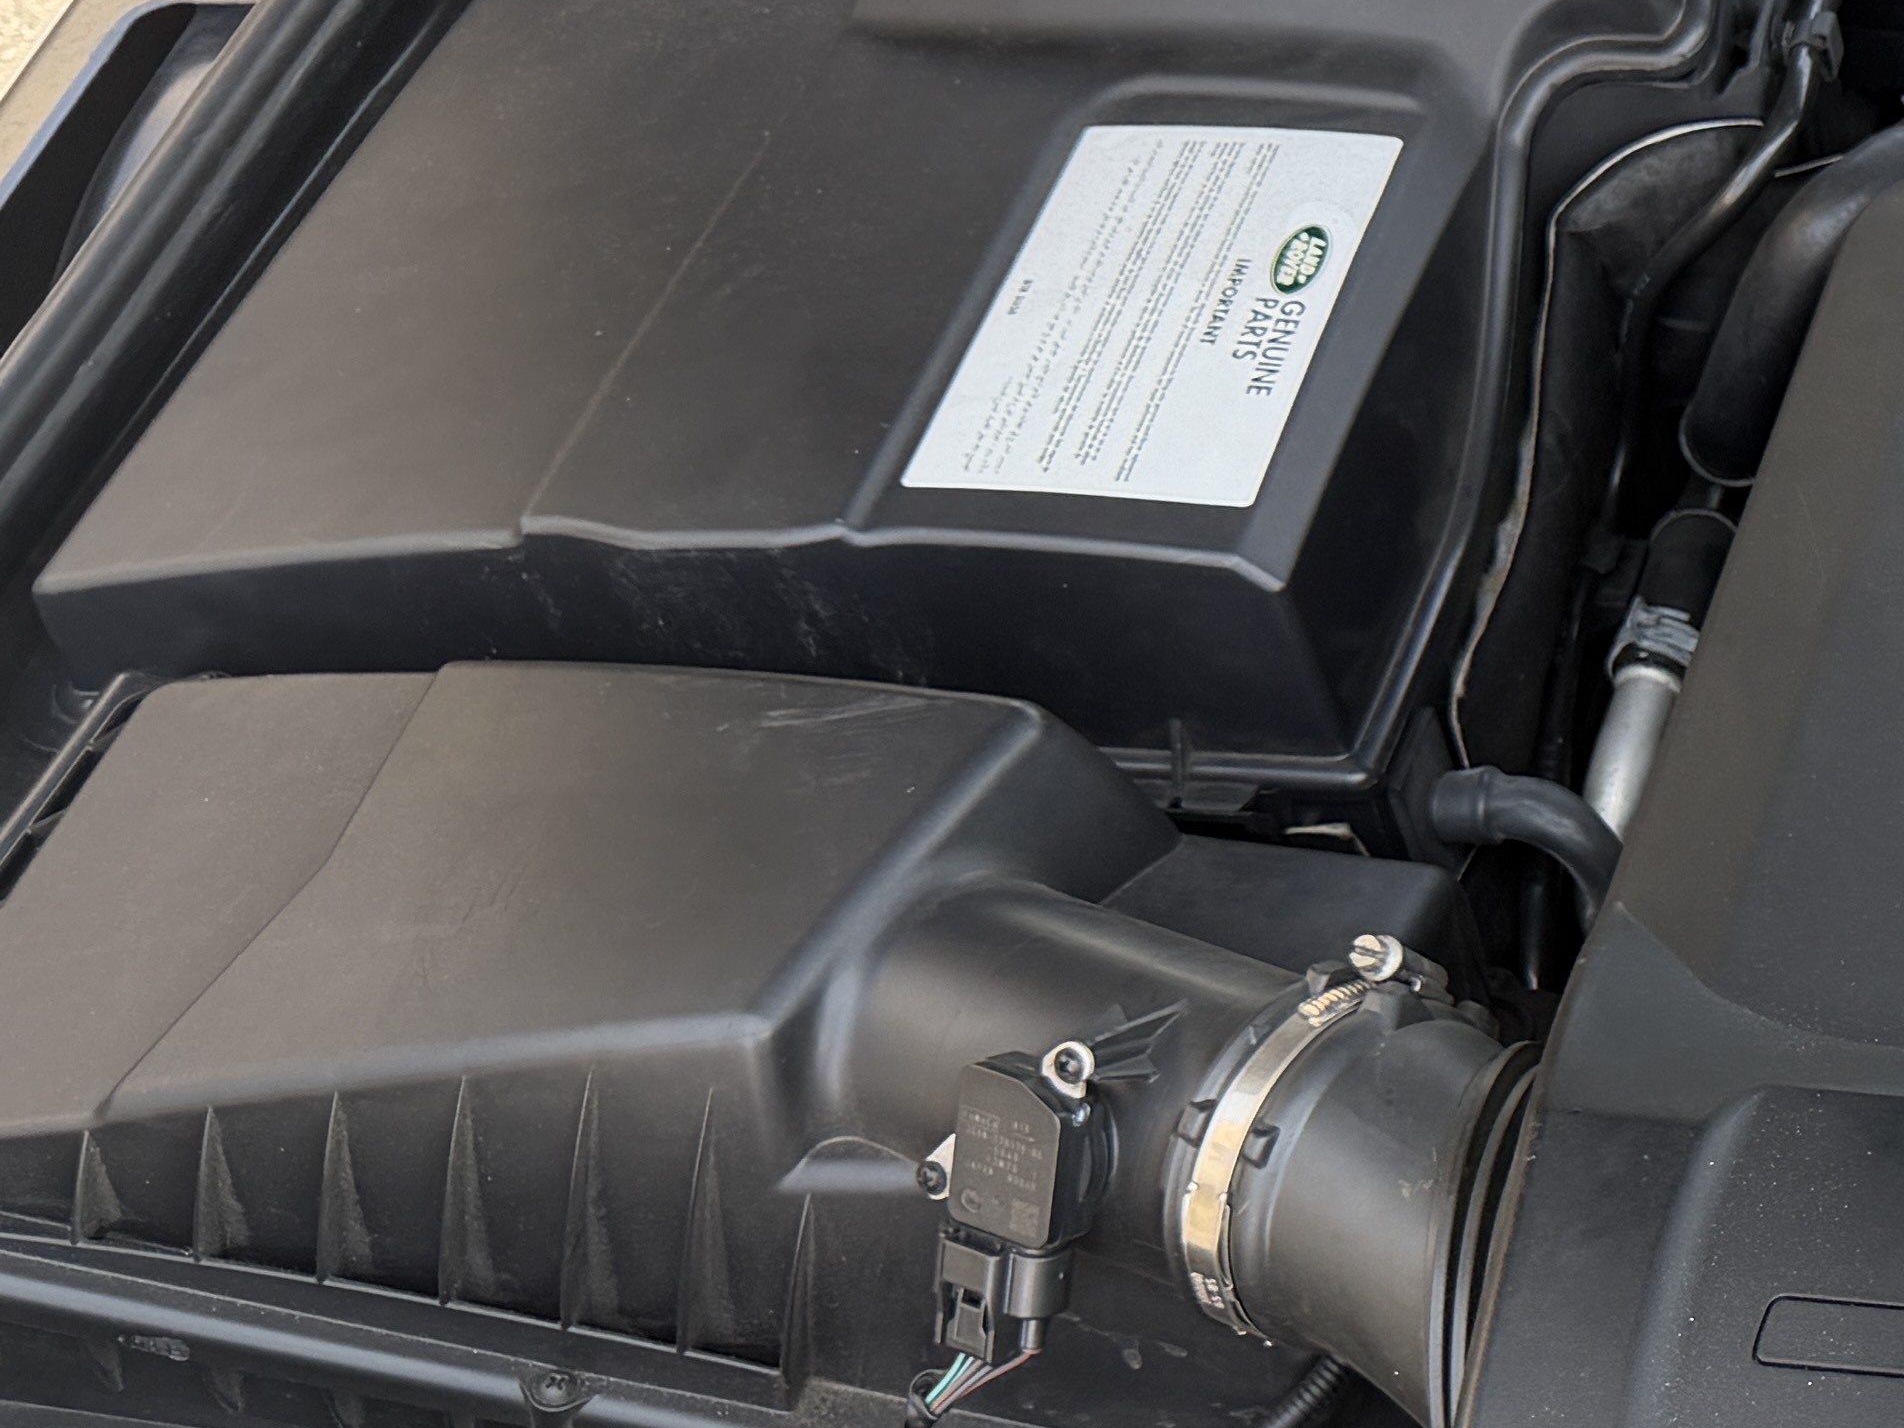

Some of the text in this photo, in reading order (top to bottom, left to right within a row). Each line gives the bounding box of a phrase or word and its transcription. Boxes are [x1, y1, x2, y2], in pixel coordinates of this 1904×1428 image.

[1276, 238, 1308, 286] ROVER
[1300, 236, 1327, 276] LAND
[1200, 258, 1252, 346] IMPORTANT
[1232, 298, 1280, 361] PARTS
[1246, 300, 1306, 396] GENUINE
